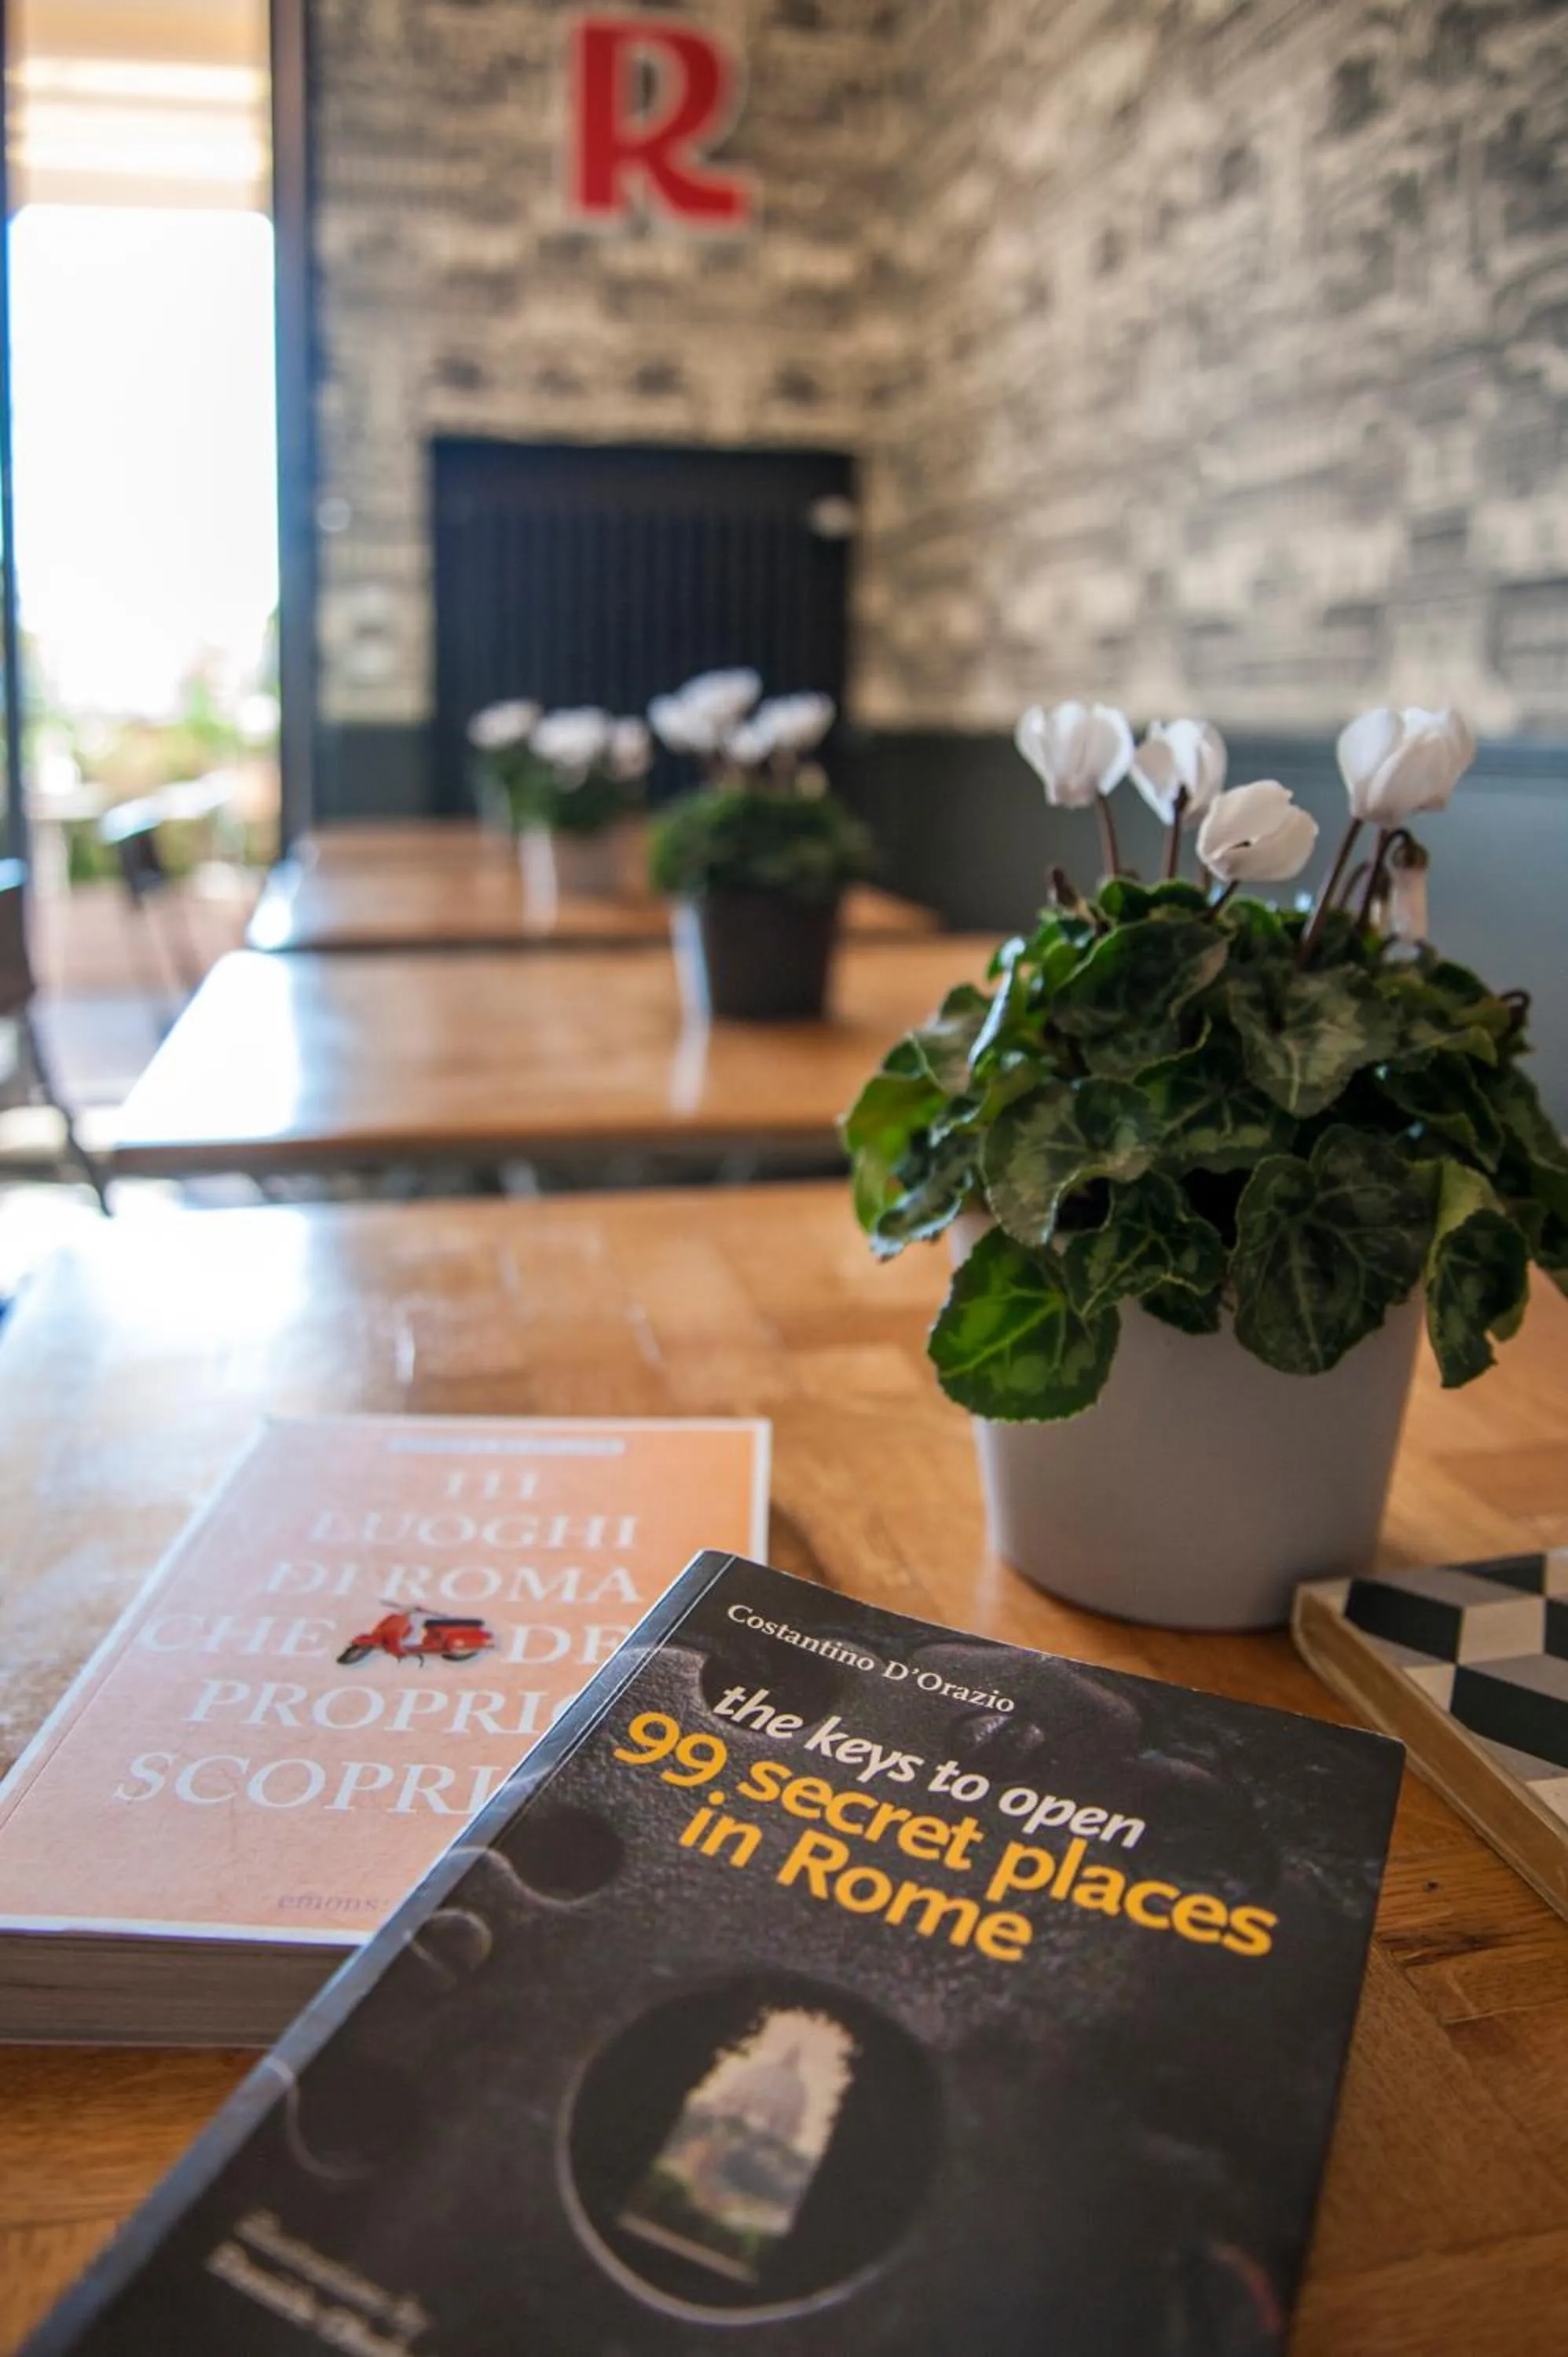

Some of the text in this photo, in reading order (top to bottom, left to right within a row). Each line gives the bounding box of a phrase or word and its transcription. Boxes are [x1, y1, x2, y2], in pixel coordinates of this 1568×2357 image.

[570, 15, 750, 226] R
[262, 1561, 645, 1604] DI ROMA
[307, 1511, 638, 1550] LUOGHI
[133, 1614, 337, 1658] CHE
[727, 1603, 1015, 1714] Costantino D'Orazio
[613, 1710, 1280, 1957] 99 secret places
[712, 1683, 1146, 1849] the keys to open
[679, 1790, 1034, 1962] in Rome
